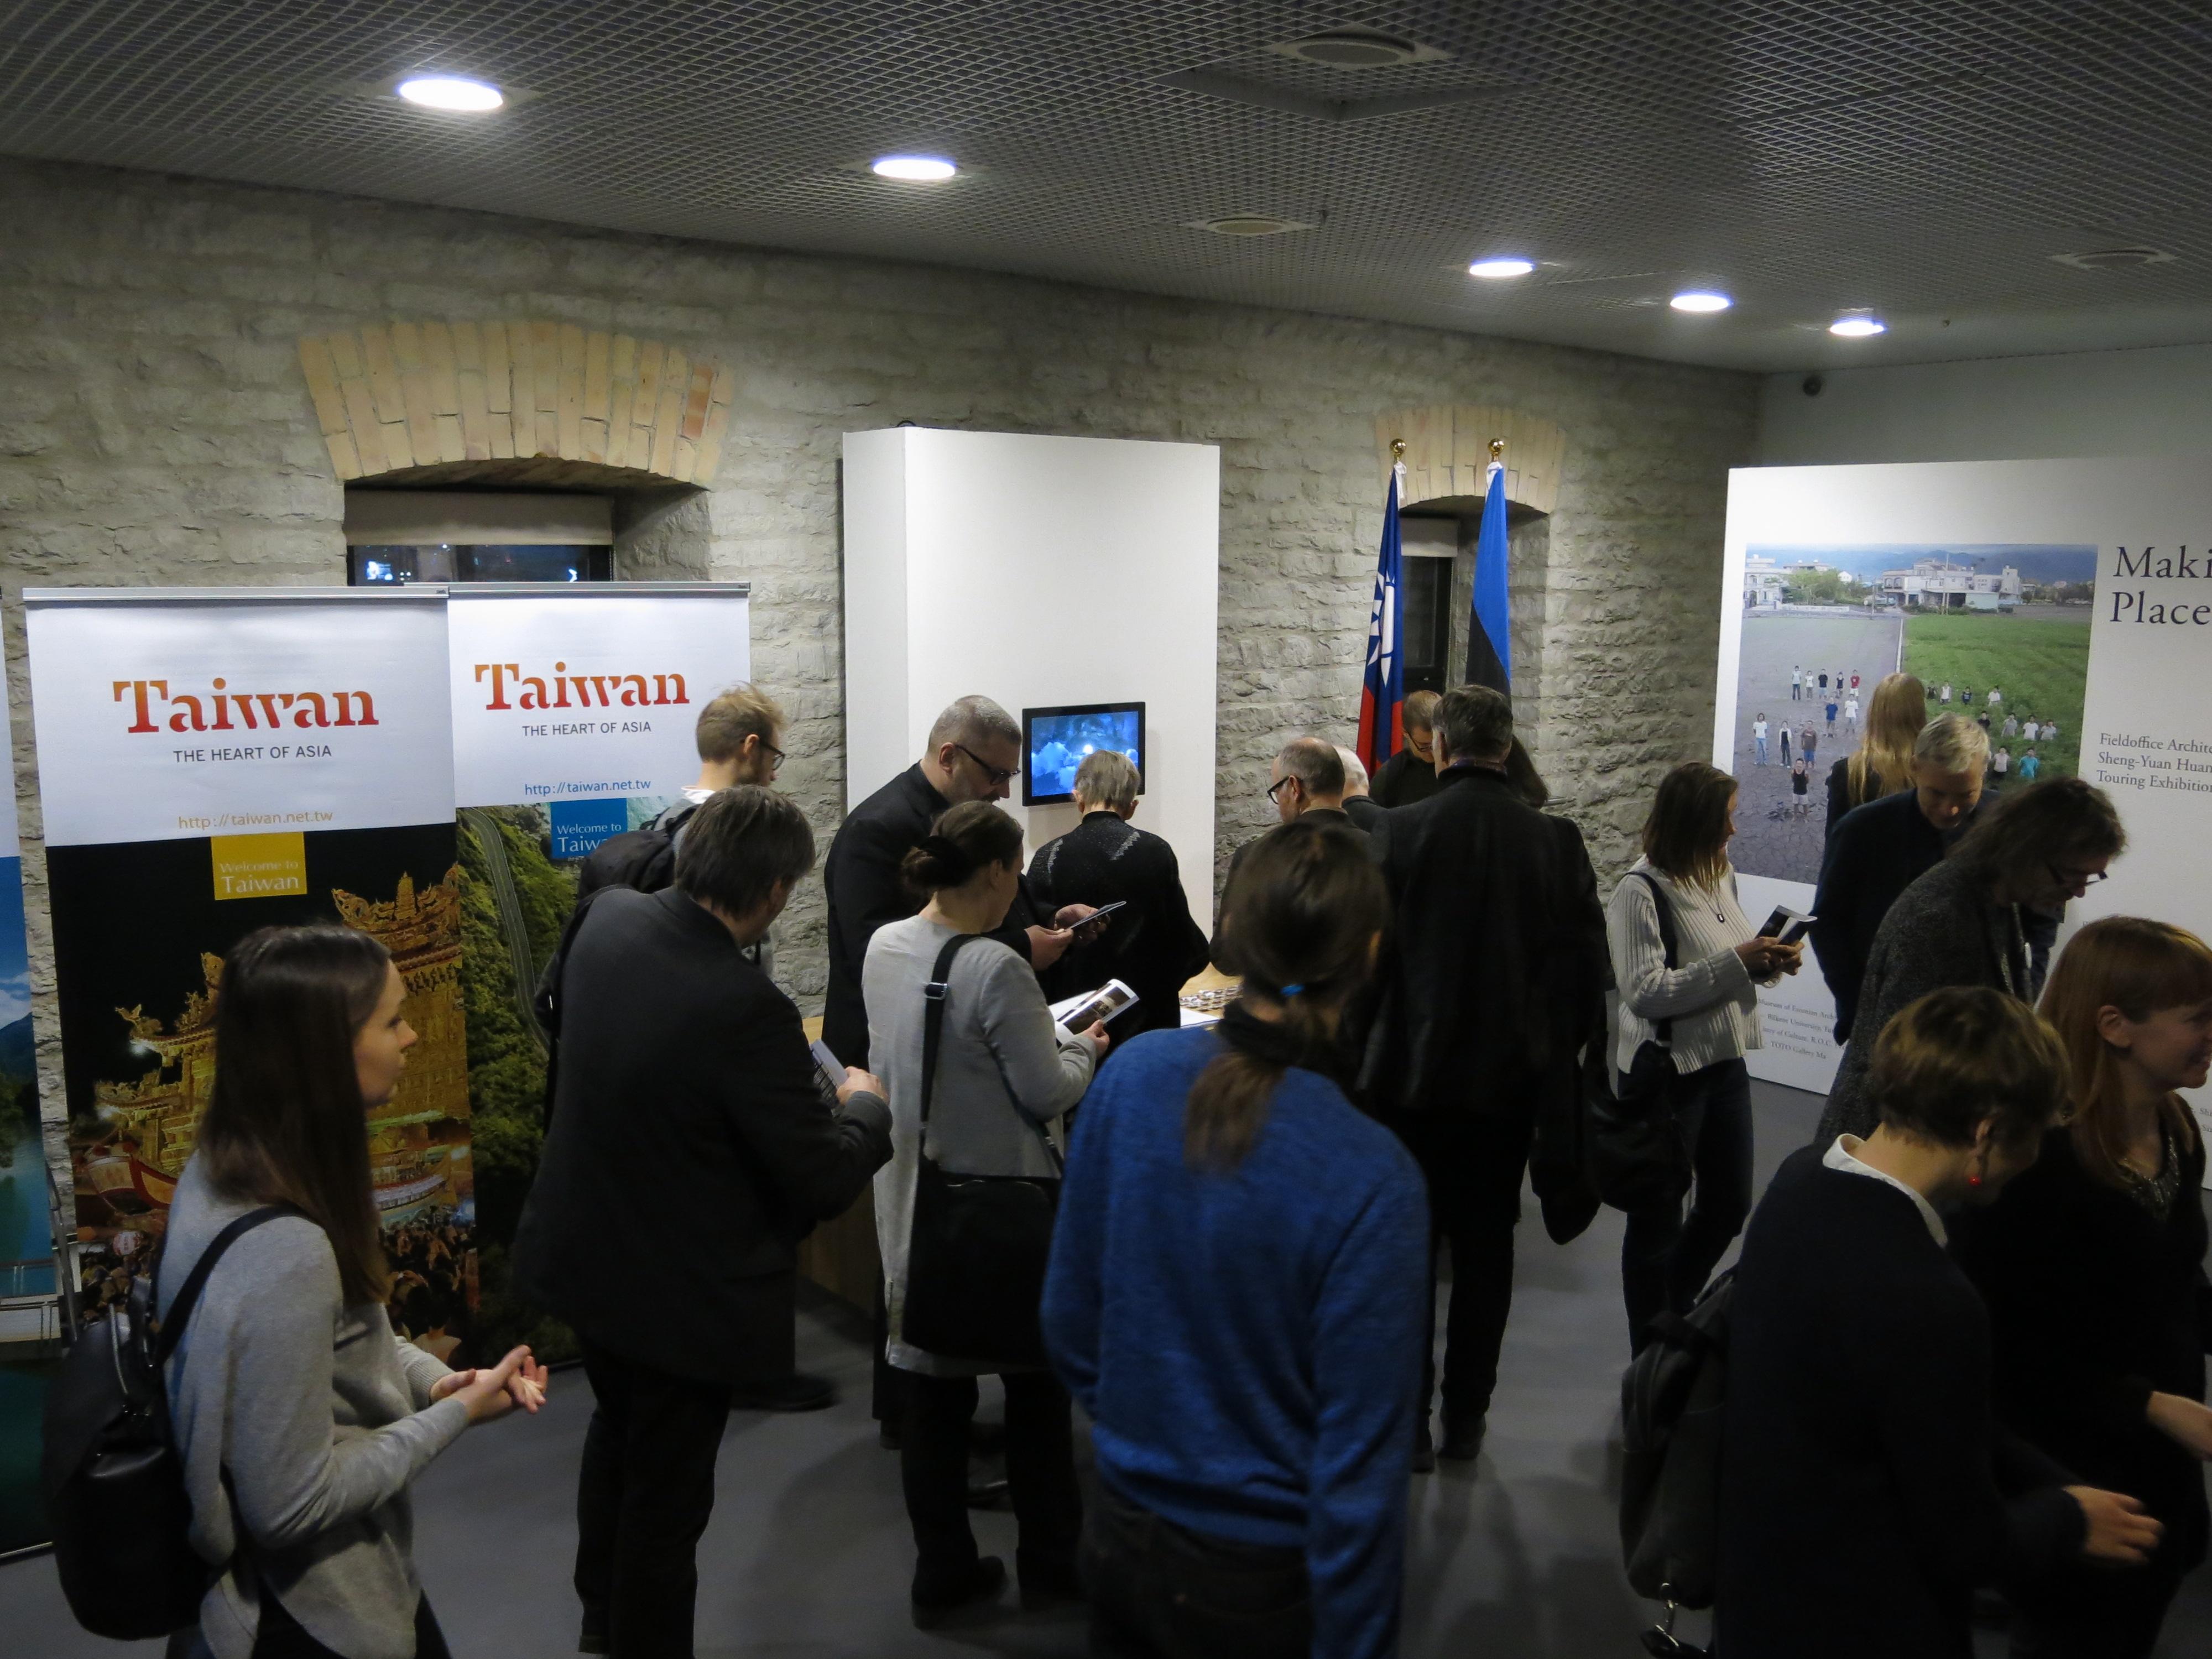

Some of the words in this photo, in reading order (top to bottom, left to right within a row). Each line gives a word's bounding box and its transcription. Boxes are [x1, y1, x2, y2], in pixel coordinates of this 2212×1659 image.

[2113, 545, 2212, 578] Maki
[2110, 591, 2211, 625] Place
[474, 661, 691, 711] Taiwan
[113, 677, 379, 734] Taiwan
[521, 724, 548, 737] THE
[552, 722, 595, 735] HEART
[600, 722, 617, 734] OF
[621, 721, 652, 733] ASIA
[2100, 733, 2164, 749] Fieldoffice
[173, 750, 206, 763] THE
[211, 747, 264, 762] HEART
[269, 746, 290, 759] OF
[295, 745, 332, 758] ASIA
[2098, 752, 2171, 770] Sheng-Yuan
[2176, 758, 2212, 773] Huan
[524, 779, 651, 796] http://taiwan.net.tw
[2096, 770, 2146, 790] Touring
[178, 811, 333, 830] http://taiwan.net.tw
[557, 823, 608, 834] Welcome
[611, 823, 622, 832] to
[557, 836, 608, 853] Taiw
[220, 860, 281, 873] Welcome
[285, 860, 299, 870] to
[221, 874, 299, 894] Taiwan
